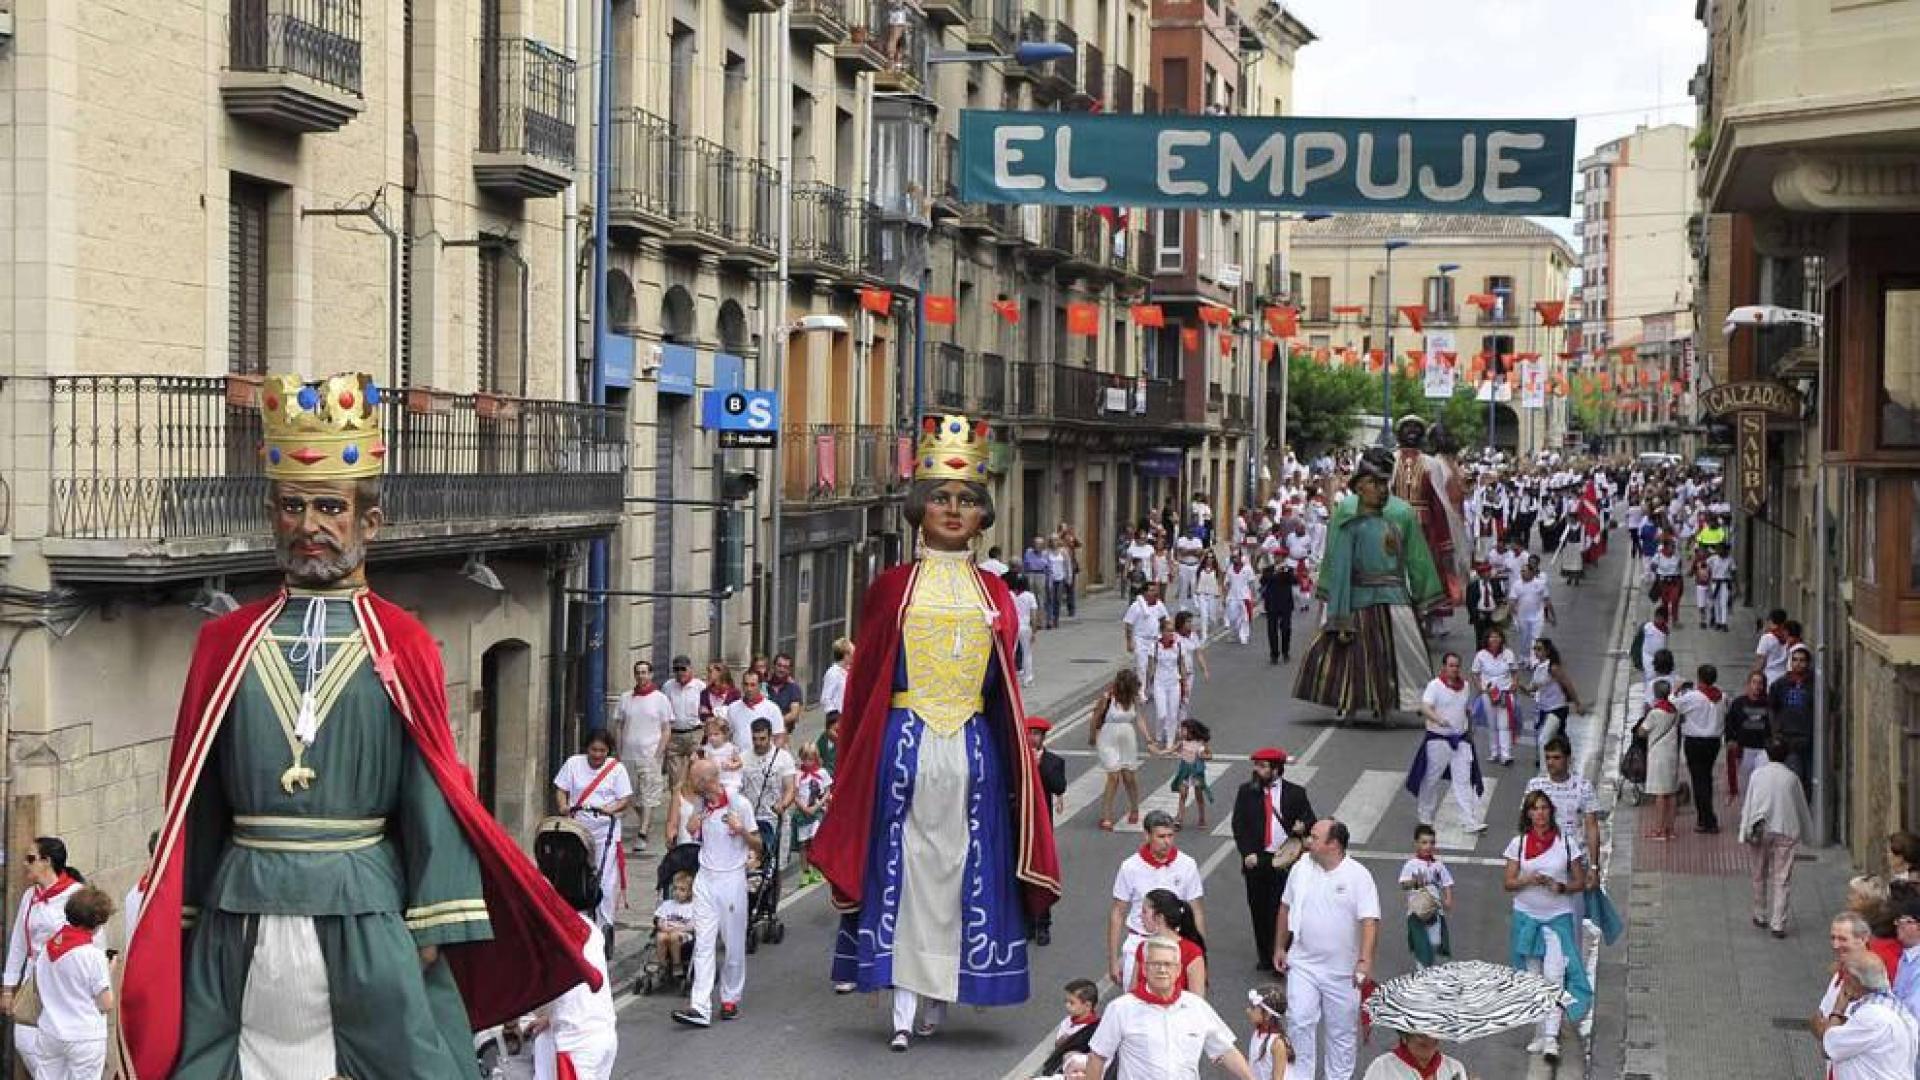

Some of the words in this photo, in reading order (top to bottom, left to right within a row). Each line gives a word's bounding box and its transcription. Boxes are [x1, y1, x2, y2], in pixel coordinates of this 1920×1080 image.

[993, 125, 1107, 193] EL
[1156, 130, 1545, 204] EMPUJE
[747, 397, 772, 429] S
[1743, 416, 1761, 507] SAMBA
